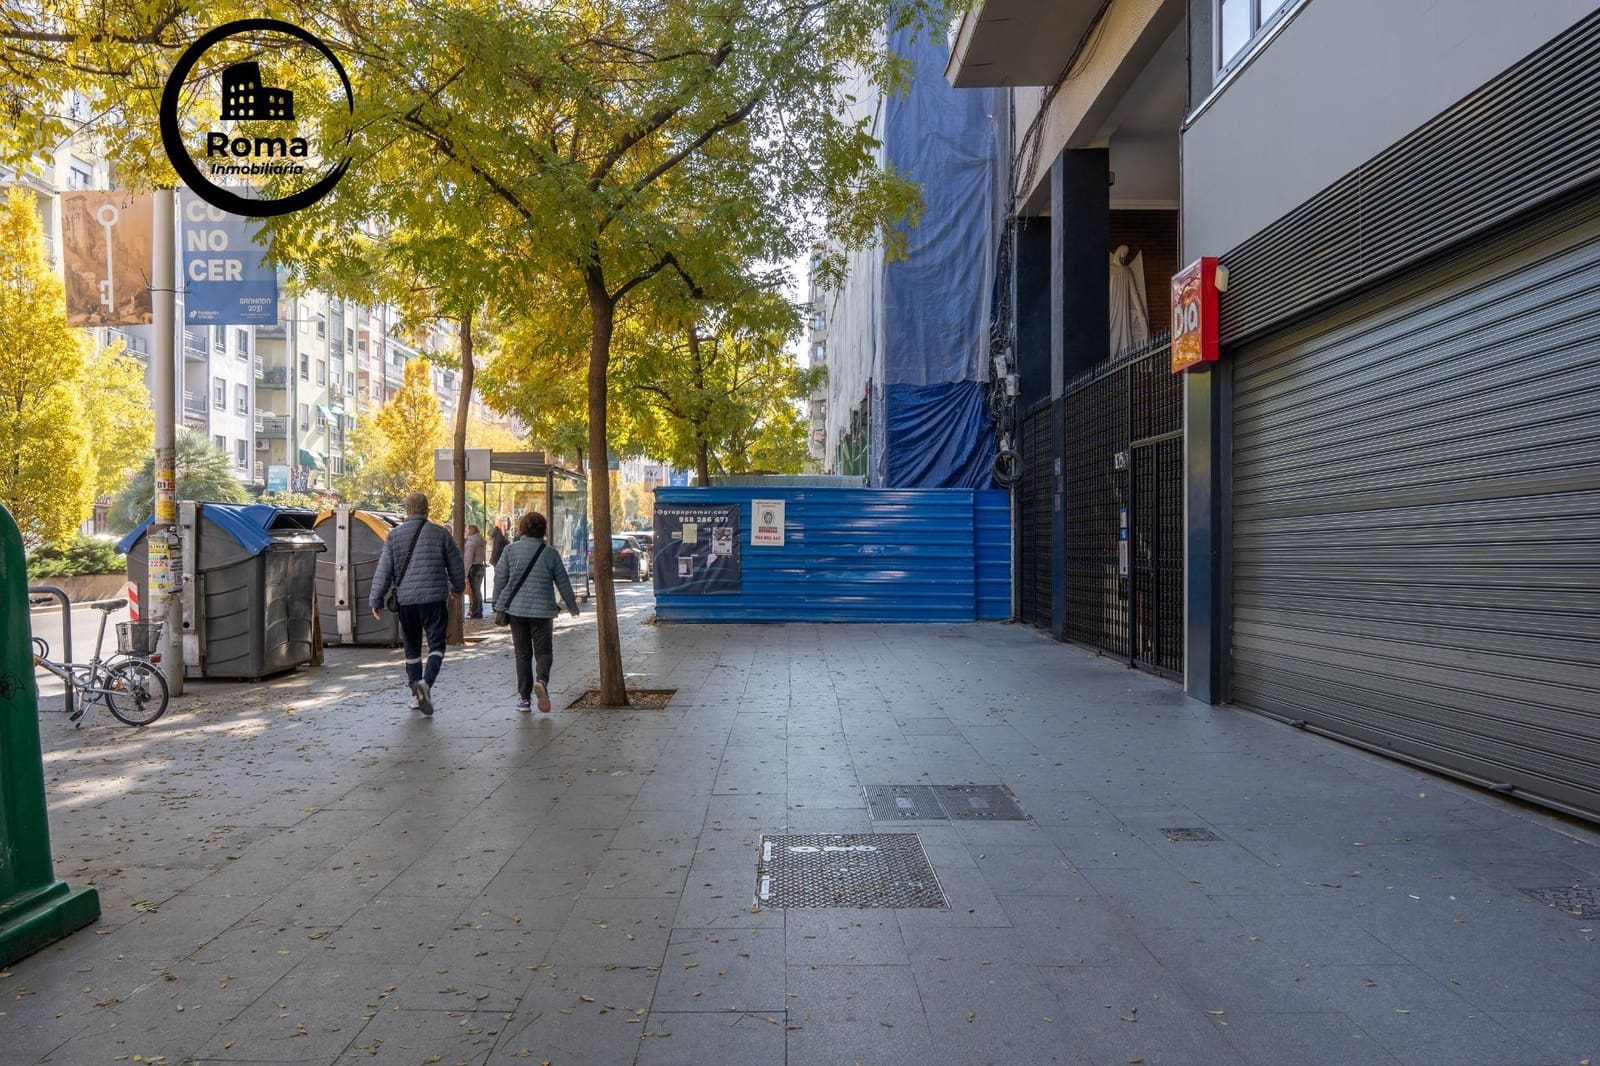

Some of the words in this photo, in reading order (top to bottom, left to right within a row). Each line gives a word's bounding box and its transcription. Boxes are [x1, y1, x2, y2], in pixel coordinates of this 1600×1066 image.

[186, 199, 226, 223] CO
[187, 229, 229, 252] NO
[188, 258, 243, 282] CER
[240, 297, 272, 305] GRANADA
[247, 305, 263, 313] 2031
